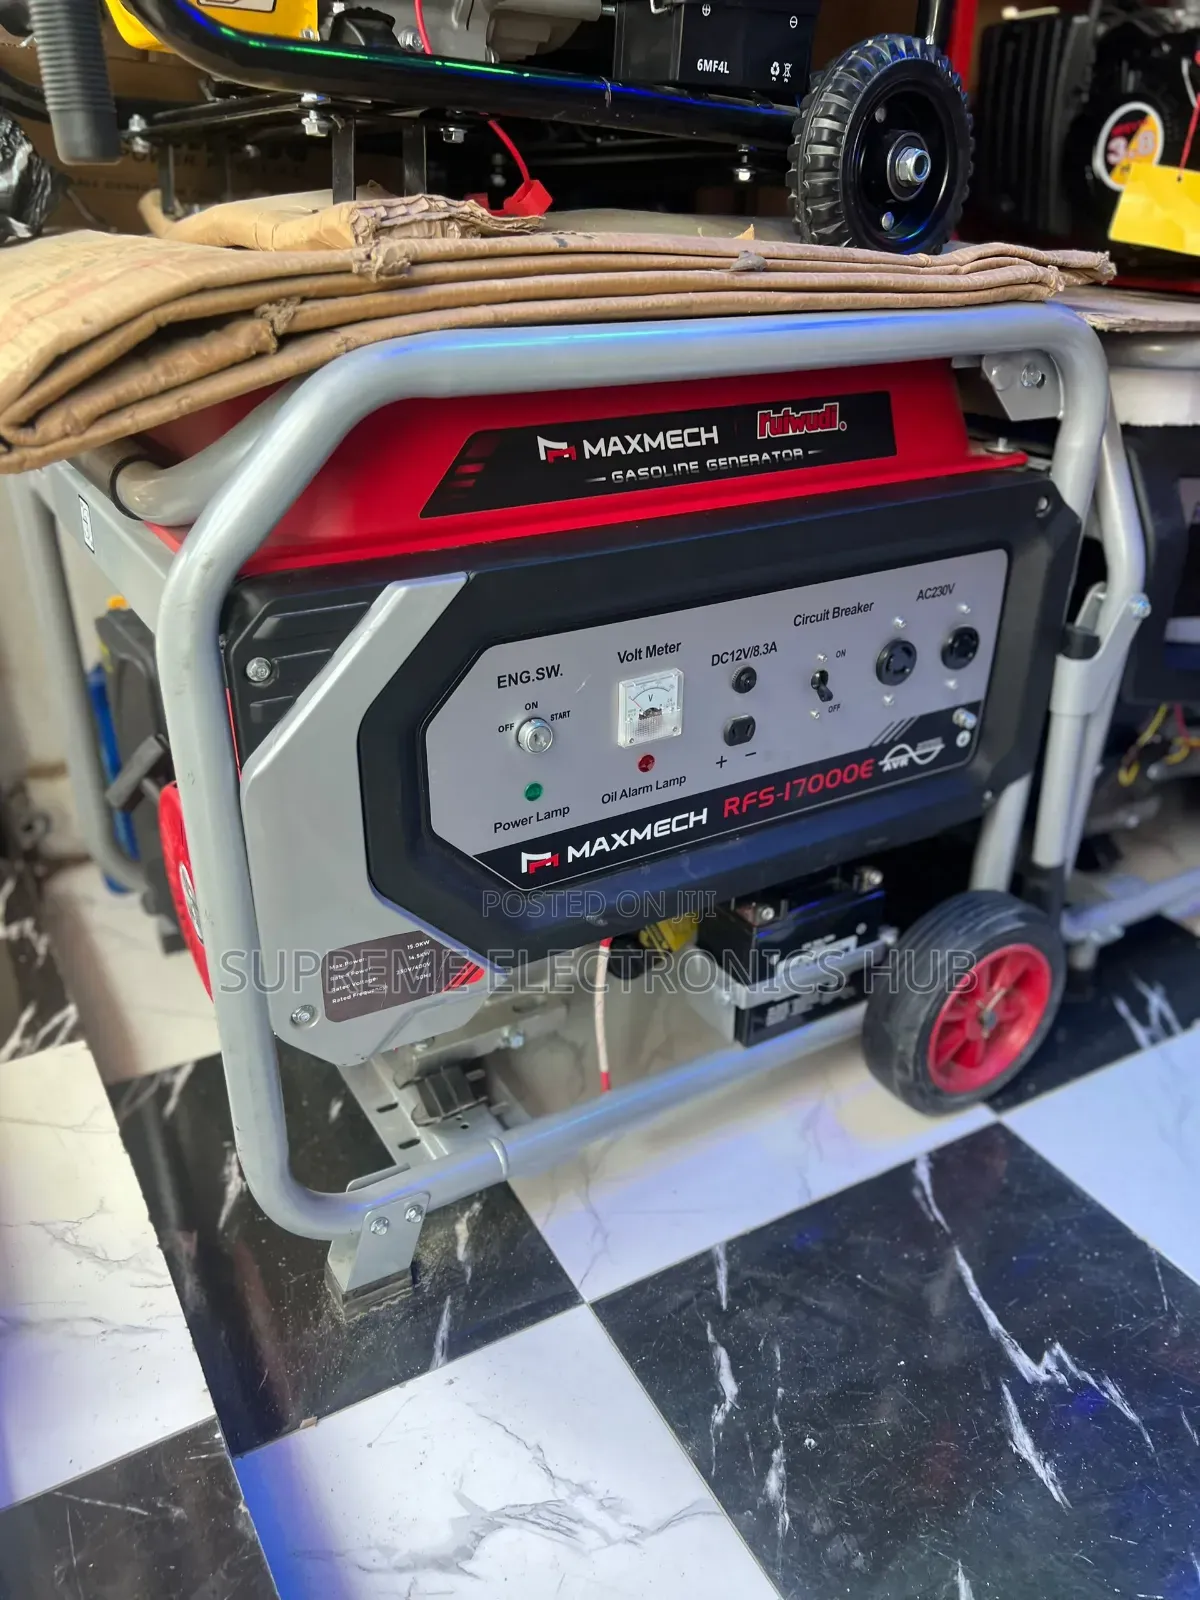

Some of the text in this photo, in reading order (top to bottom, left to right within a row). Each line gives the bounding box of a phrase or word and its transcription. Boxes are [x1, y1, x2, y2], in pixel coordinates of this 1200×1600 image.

[696, 58, 730, 75] 6MF4L
[582, 425, 719, 460] MAXMECH
[611, 447, 804, 484] GASOLINE GENERATOR
[916, 583, 955, 601] AC230V
[793, 601, 875, 627] Circuit Breaker
[617, 641, 682, 664] Volt Meter
[711, 641, 778, 667] DC12V/8.3A
[835, 649, 847, 659] ON
[497, 664, 564, 689] ENG.SW.
[524, 701, 539, 711] ON
[550, 710, 571, 722] START
[498, 722, 515, 733] OFF
[601, 774, 687, 805] Oil Alarm Lamp
[493, 805, 571, 834] Power Lamp
[567, 758, 875, 864] MAXMECH RFS-17000E
